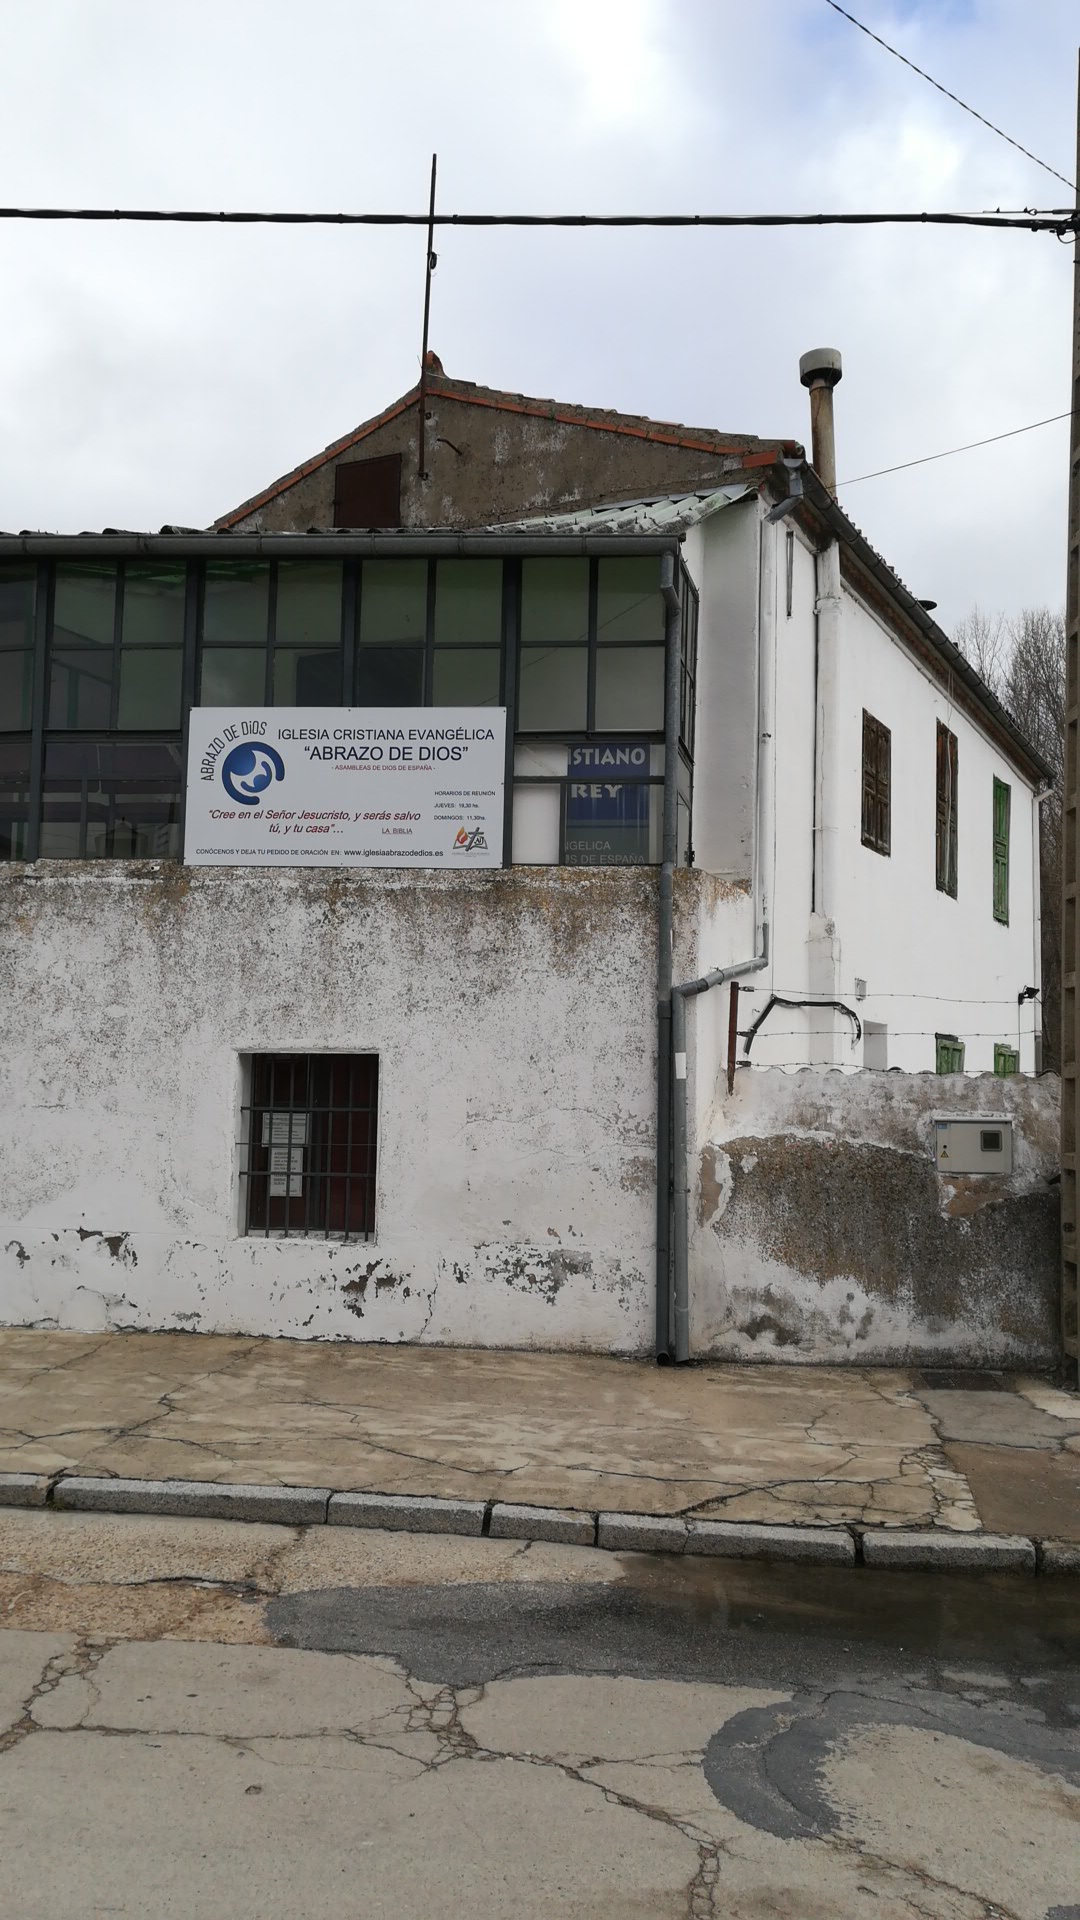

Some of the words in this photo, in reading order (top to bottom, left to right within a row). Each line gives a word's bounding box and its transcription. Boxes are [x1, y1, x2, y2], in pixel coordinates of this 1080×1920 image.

[278, 729, 329, 740] IGLESIA
[333, 729, 405, 740] CRISTIANA
[408, 727, 495, 741] EVANGÉLICA
[200, 737, 225, 781] ABRAZO
[223, 724, 240, 742] DE
[389, 746, 413, 761] DE
[571, 783, 623, 798] REY
[238, 811, 251, 819] en
[253, 810, 263, 819] el
[265, 810, 296, 819] Señor
[297, 810, 351, 821] Jesucristo,
[353, 812, 361, 822] y
[363, 811, 391, 820] serás
[393, 811, 421, 820] salvo
[268, 823, 281, 834] tú,
[283, 825, 292, 835] y
[293, 824, 304, 833] tu
[343, 849, 444, 857] www.iglesiaabrazodedios.es
[581, 855, 597, 864] DE
[600, 853, 645, 864] ESPAÑA
